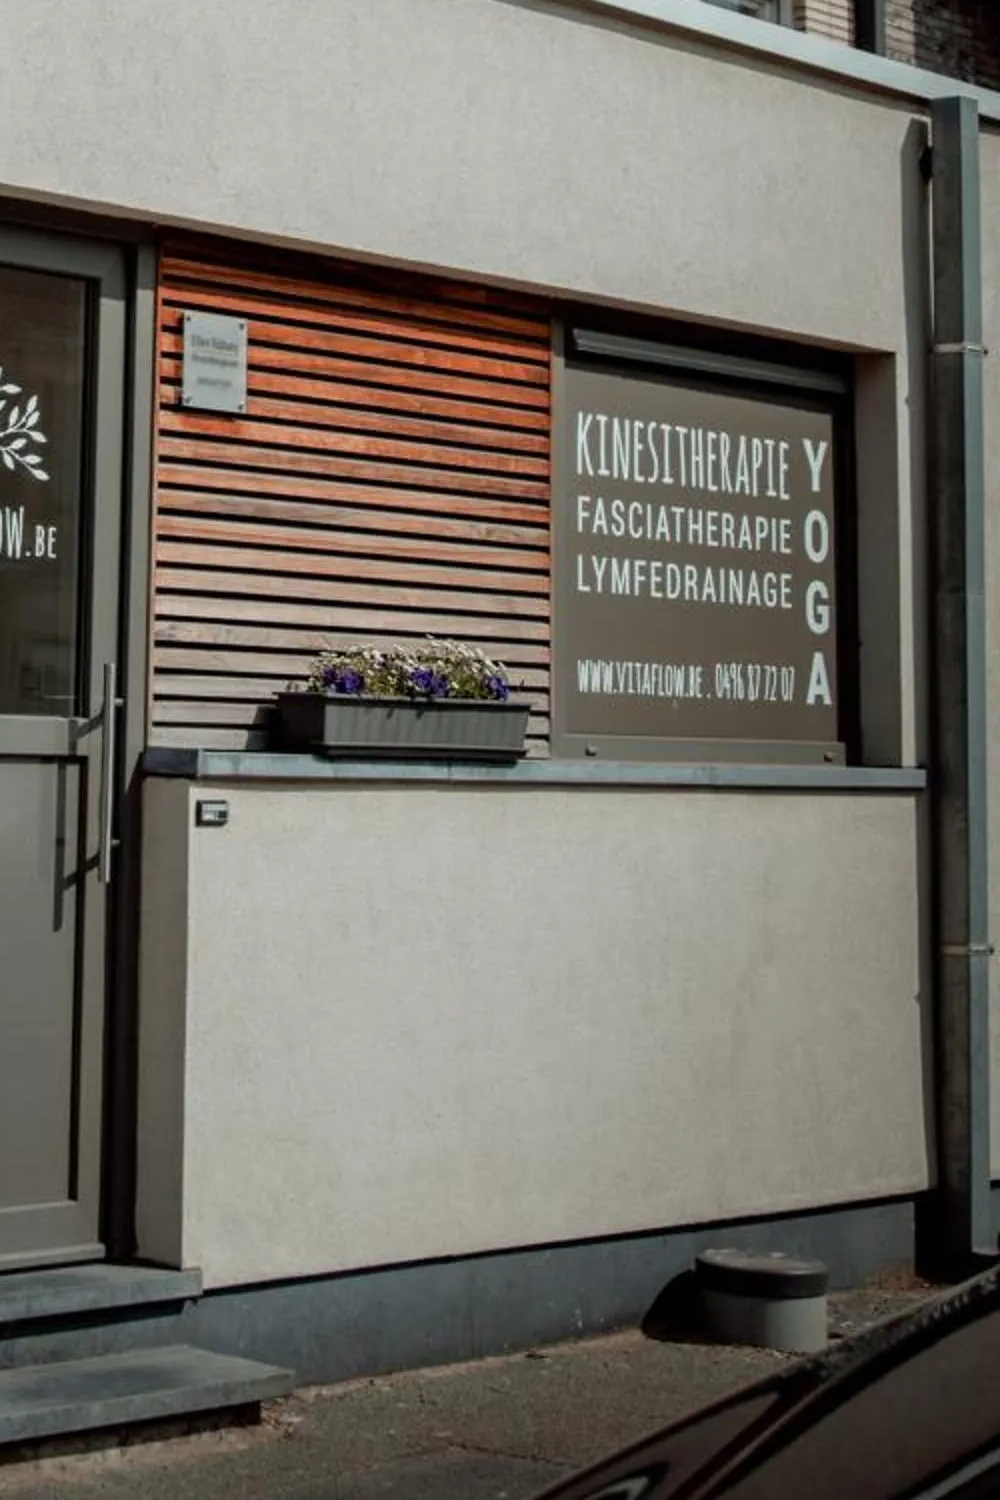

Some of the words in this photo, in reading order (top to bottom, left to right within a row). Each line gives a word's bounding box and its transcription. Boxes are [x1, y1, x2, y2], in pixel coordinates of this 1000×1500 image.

[576, 411, 791, 501] KINESITHERAPIE
[576, 495, 792, 555] FASCIATHERAPIE
[576, 554, 793, 609] LYMFEDRAINAGE
[802, 438, 832, 706] YOGA
